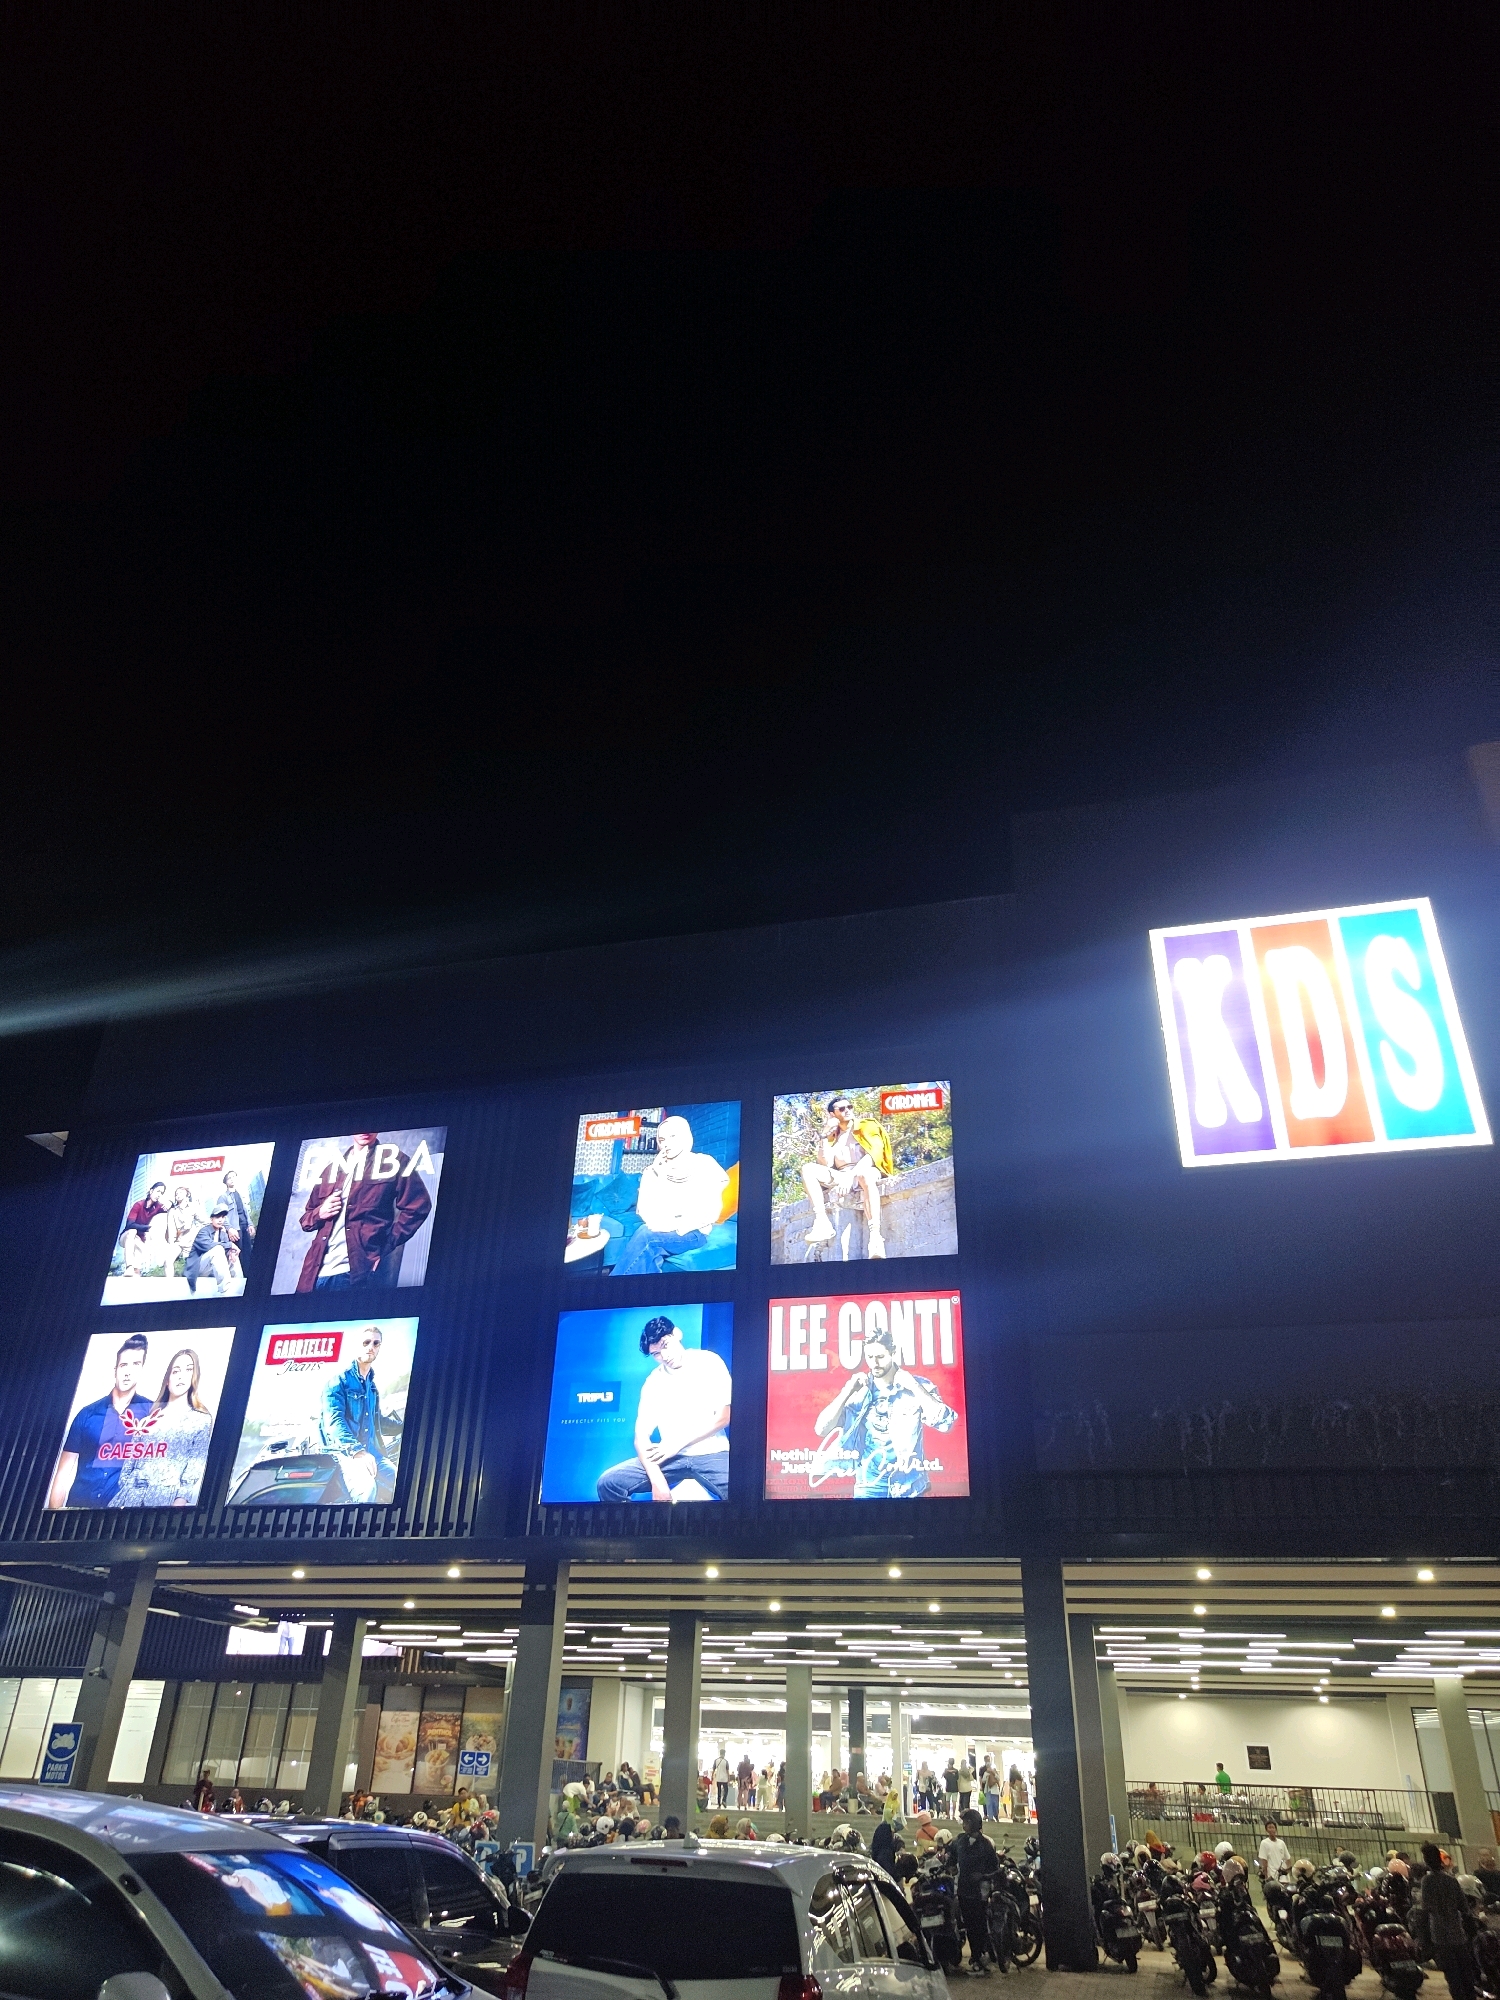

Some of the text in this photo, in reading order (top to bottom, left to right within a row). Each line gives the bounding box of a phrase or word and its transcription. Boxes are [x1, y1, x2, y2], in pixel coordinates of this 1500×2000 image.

[1173, 934, 1444, 1128] KDS
[884, 1091, 940, 1111] CARDINAL
[588, 1120, 637, 1138] CARDINAL
[173, 1160, 222, 1173] CRESSIDA
[300, 1139, 435, 1185] EMBA
[771, 1304, 828, 1371] LEE
[276, 1360, 324, 1376] Jeans
[99, 1442, 168, 1459] CAESAR
[45, 1771, 66, 1780] MOTOR
[47, 1763, 69, 1772] PARKIR
